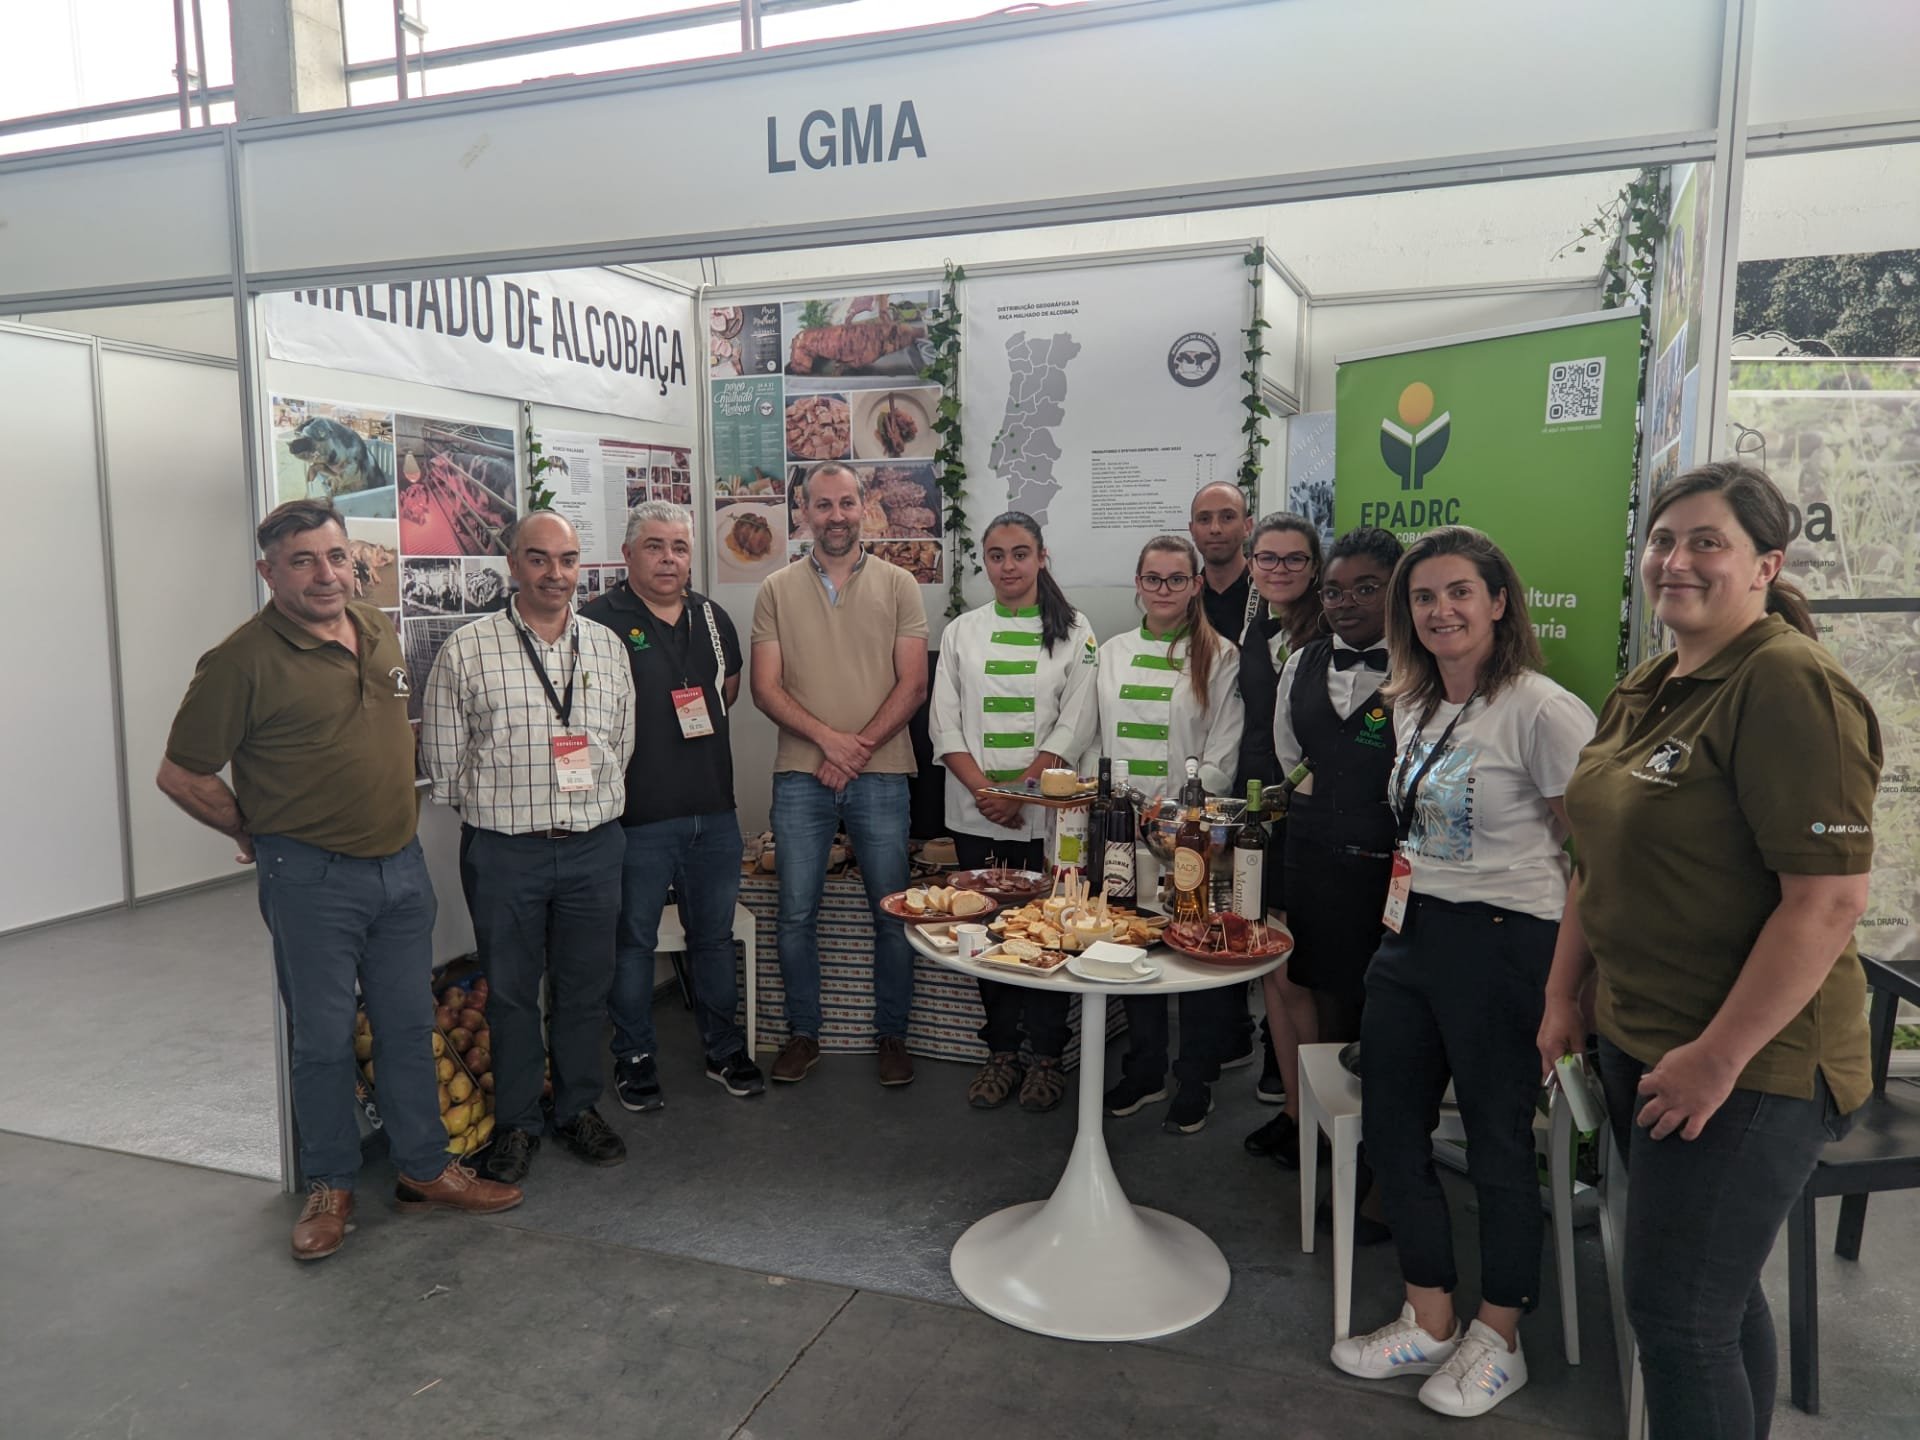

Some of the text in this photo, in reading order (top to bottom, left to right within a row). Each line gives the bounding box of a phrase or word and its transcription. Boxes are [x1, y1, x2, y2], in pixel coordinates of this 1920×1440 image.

[767, 99, 927, 174] LGMA
[1013, 310, 1041, 319] MALHADO
[1049, 308, 1079, 316] ALCOBAÇA
[503, 281, 545, 355] DE
[551, 296, 687, 396] ALCOBAÇA
[1360, 498, 1460, 529] EPADRC
[1827, 824, 1847, 834] AIM
